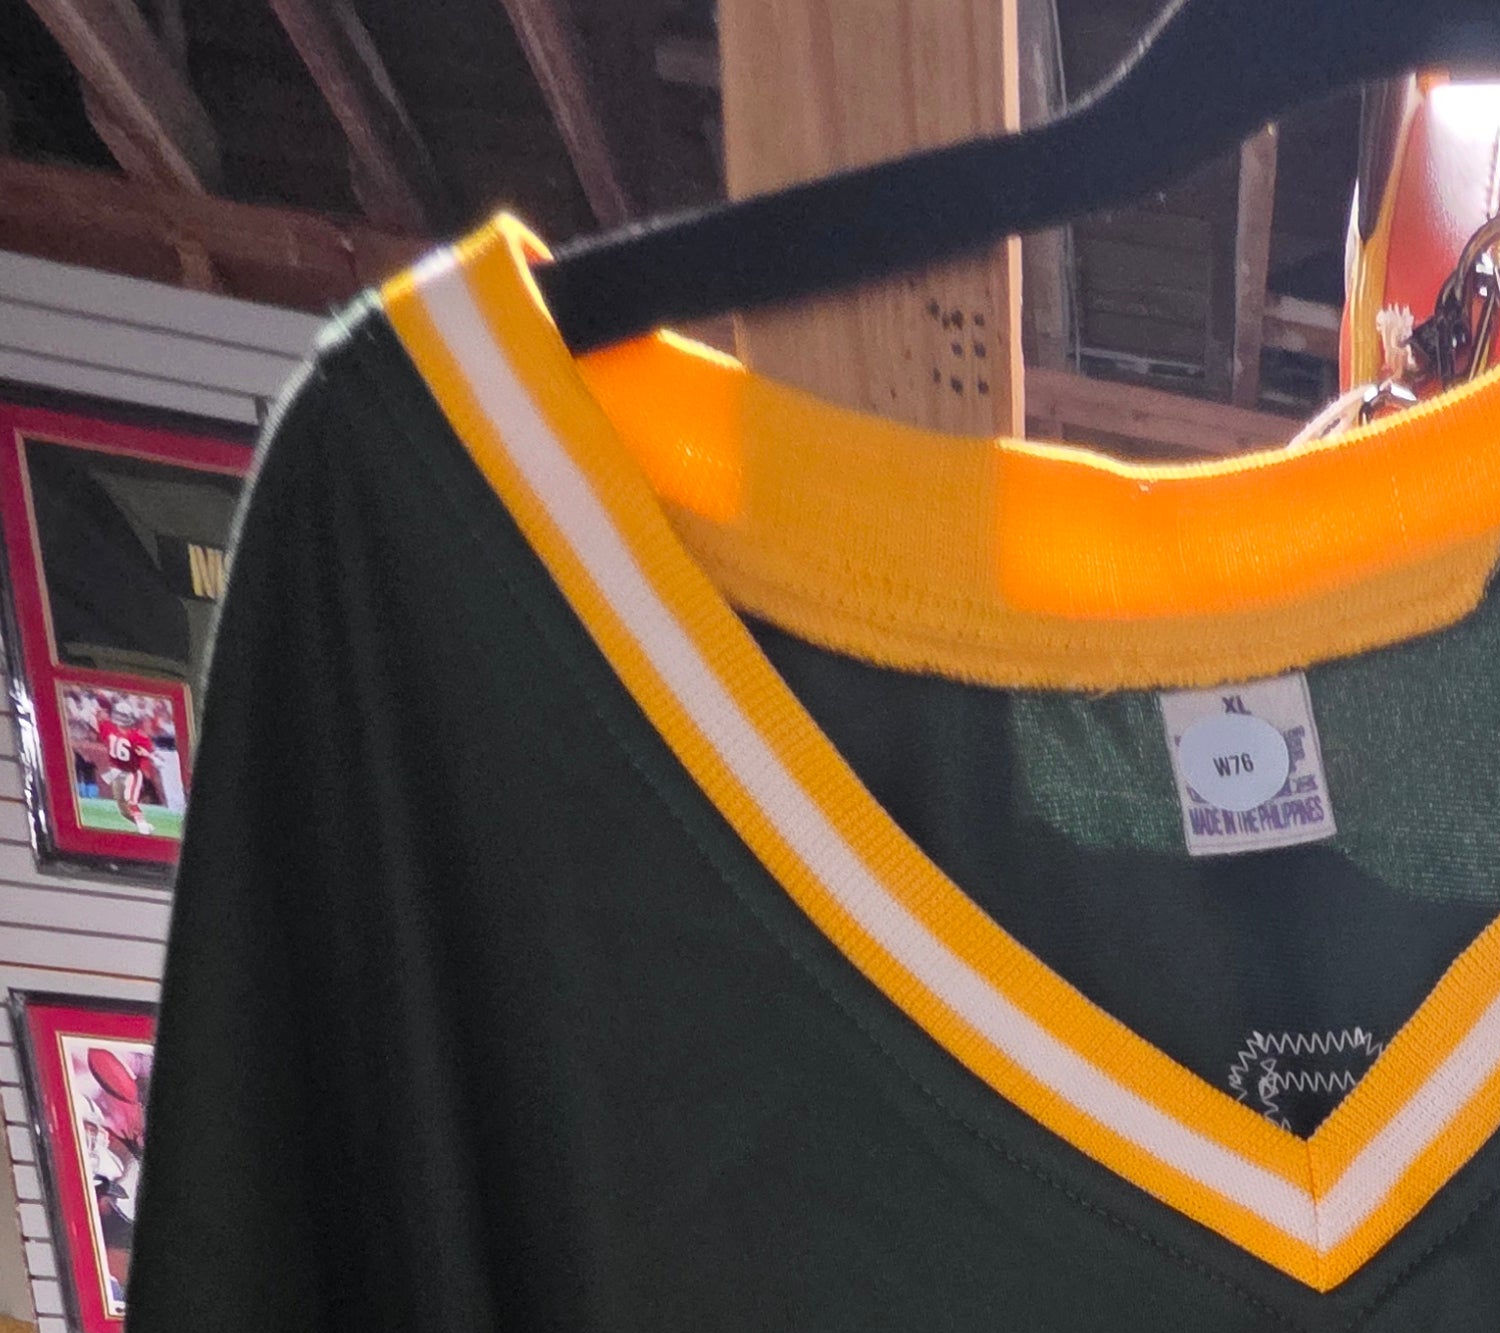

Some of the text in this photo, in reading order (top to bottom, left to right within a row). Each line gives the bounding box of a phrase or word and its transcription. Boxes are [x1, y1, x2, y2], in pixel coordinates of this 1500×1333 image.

[1222, 695, 1252, 715] XL
[109, 734, 132, 762] 16
[1188, 806, 1224, 836] MADE
